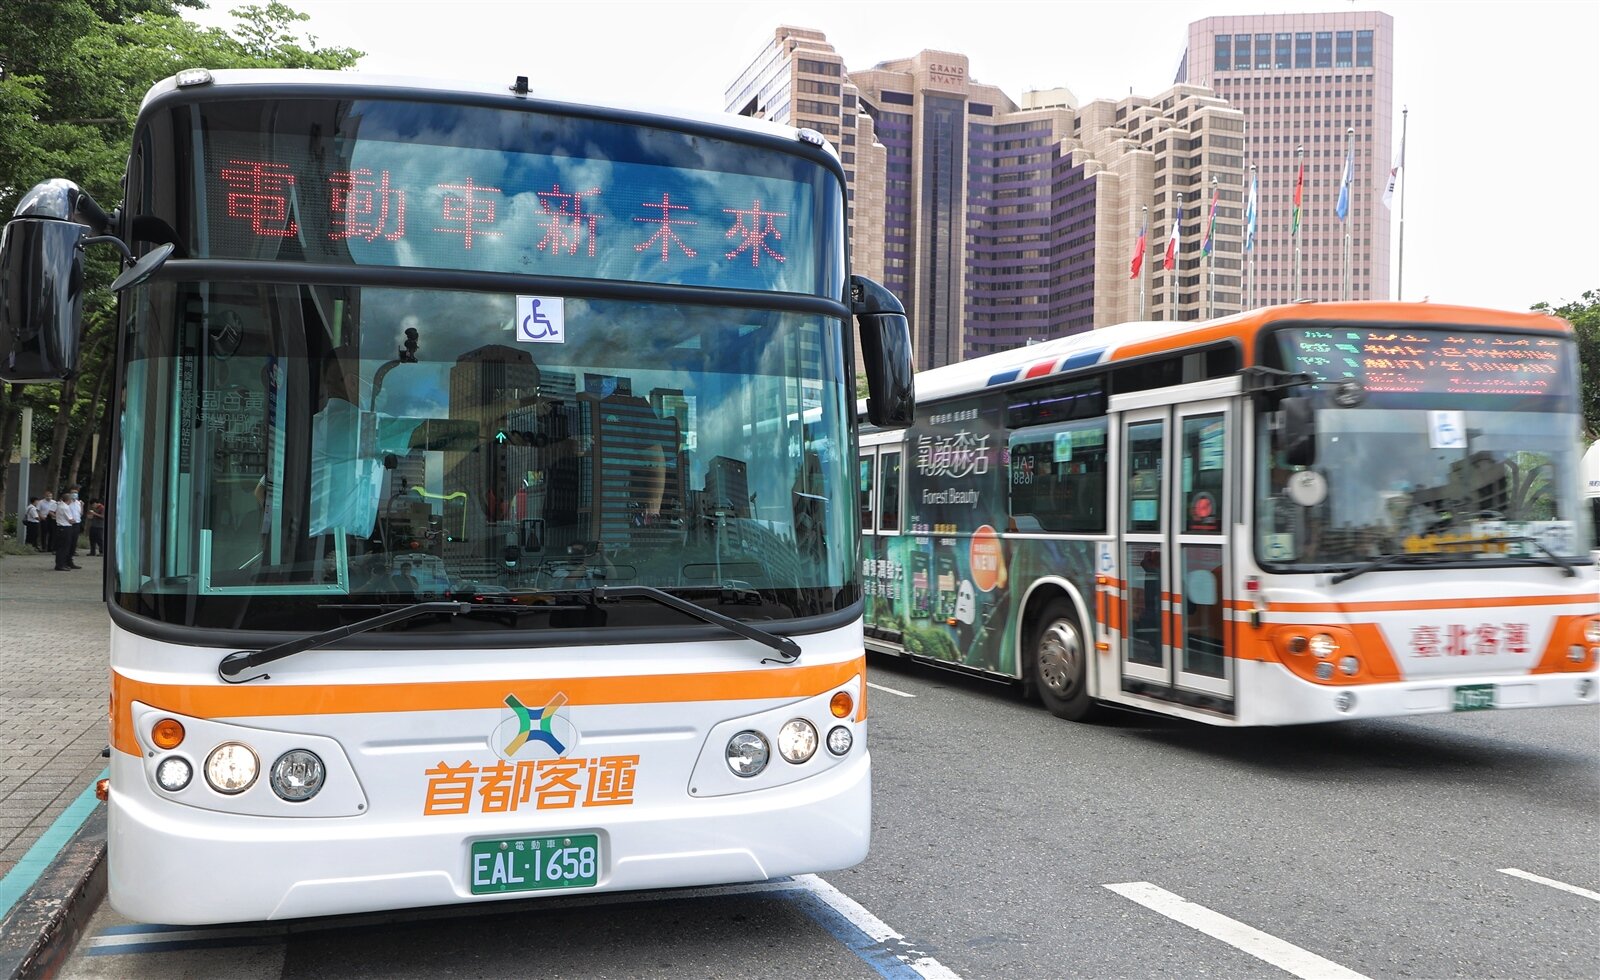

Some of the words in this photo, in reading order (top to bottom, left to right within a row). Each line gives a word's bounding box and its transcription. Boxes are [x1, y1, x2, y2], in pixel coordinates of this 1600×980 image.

[929, 63, 964, 75] GRAND
[929, 75, 963, 86] HYATT
[221, 159, 788, 268] 電動車新未來
[922, 488, 949, 505] Forest
[949, 487, 980, 509] Beauty
[973, 554, 997, 571] NEW
[423, 754, 640, 816] 首都客運
[514, 839, 557, 851] 電動車
